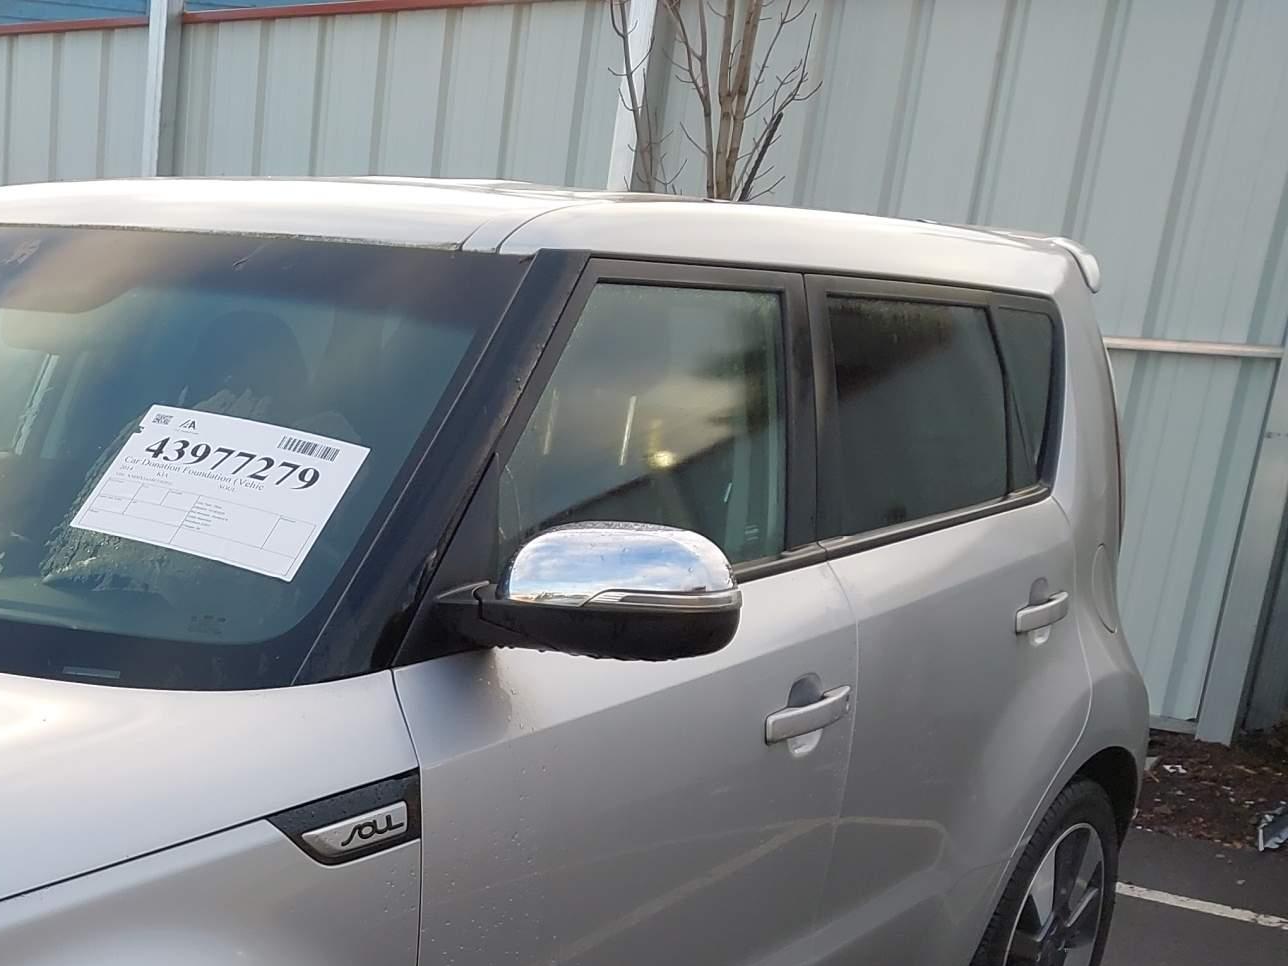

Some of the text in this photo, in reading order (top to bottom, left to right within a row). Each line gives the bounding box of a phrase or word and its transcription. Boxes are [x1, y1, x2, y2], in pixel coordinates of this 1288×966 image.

[124, 455, 141, 464] Car
[142, 458, 181, 473] Donation
[182, 465, 232, 482] Foundation
[232, 478, 265, 491] (Vehic
[145, 436, 321, 490] 43977279
